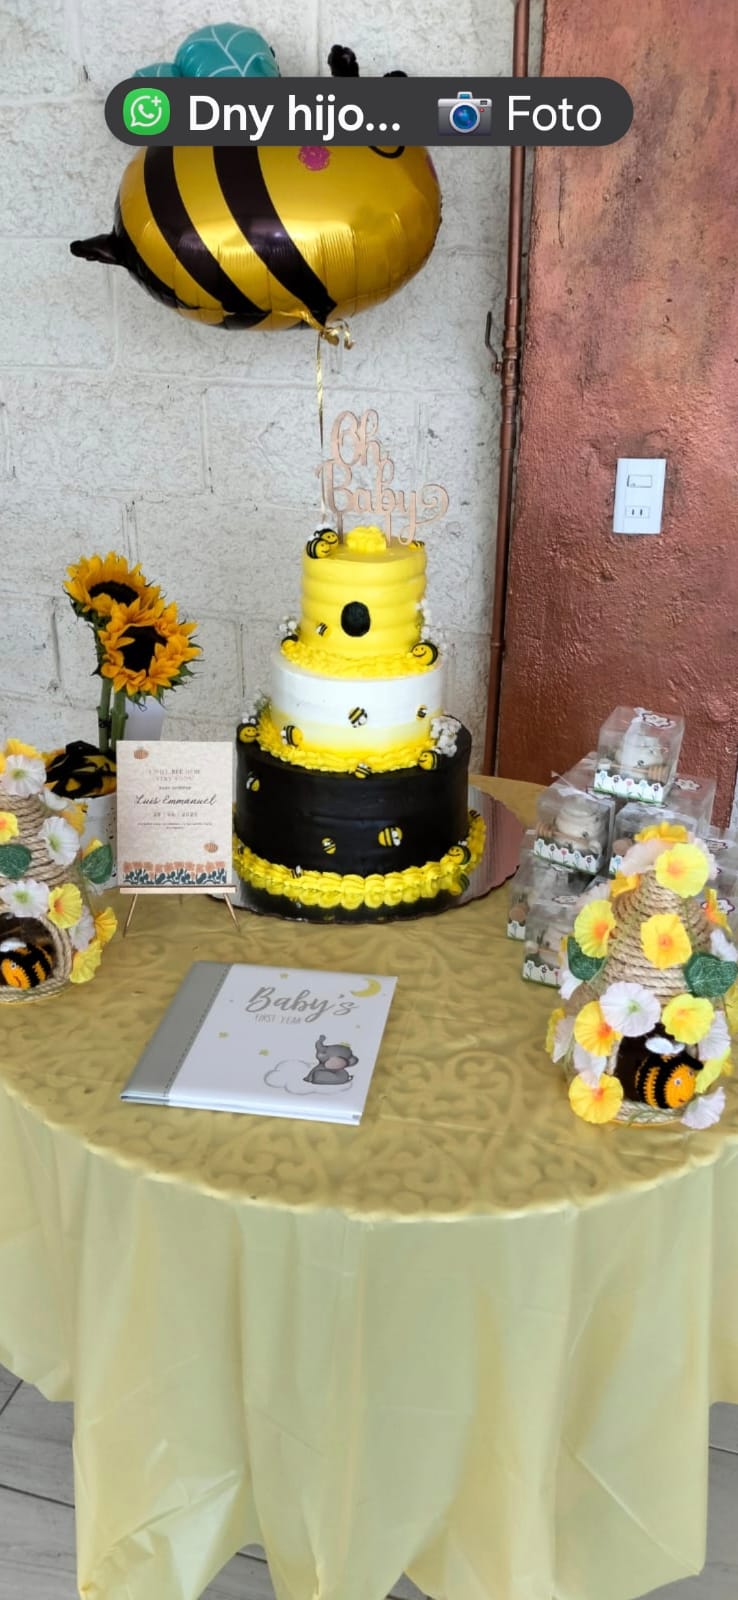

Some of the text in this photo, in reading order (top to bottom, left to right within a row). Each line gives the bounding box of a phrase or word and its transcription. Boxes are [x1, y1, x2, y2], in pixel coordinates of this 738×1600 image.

[331, 409, 383, 467] Oh
[315, 456, 450, 545] Baby
[136, 793, 217, 806] Luis Emmanuel
[245, 986, 359, 1023] Baby's
